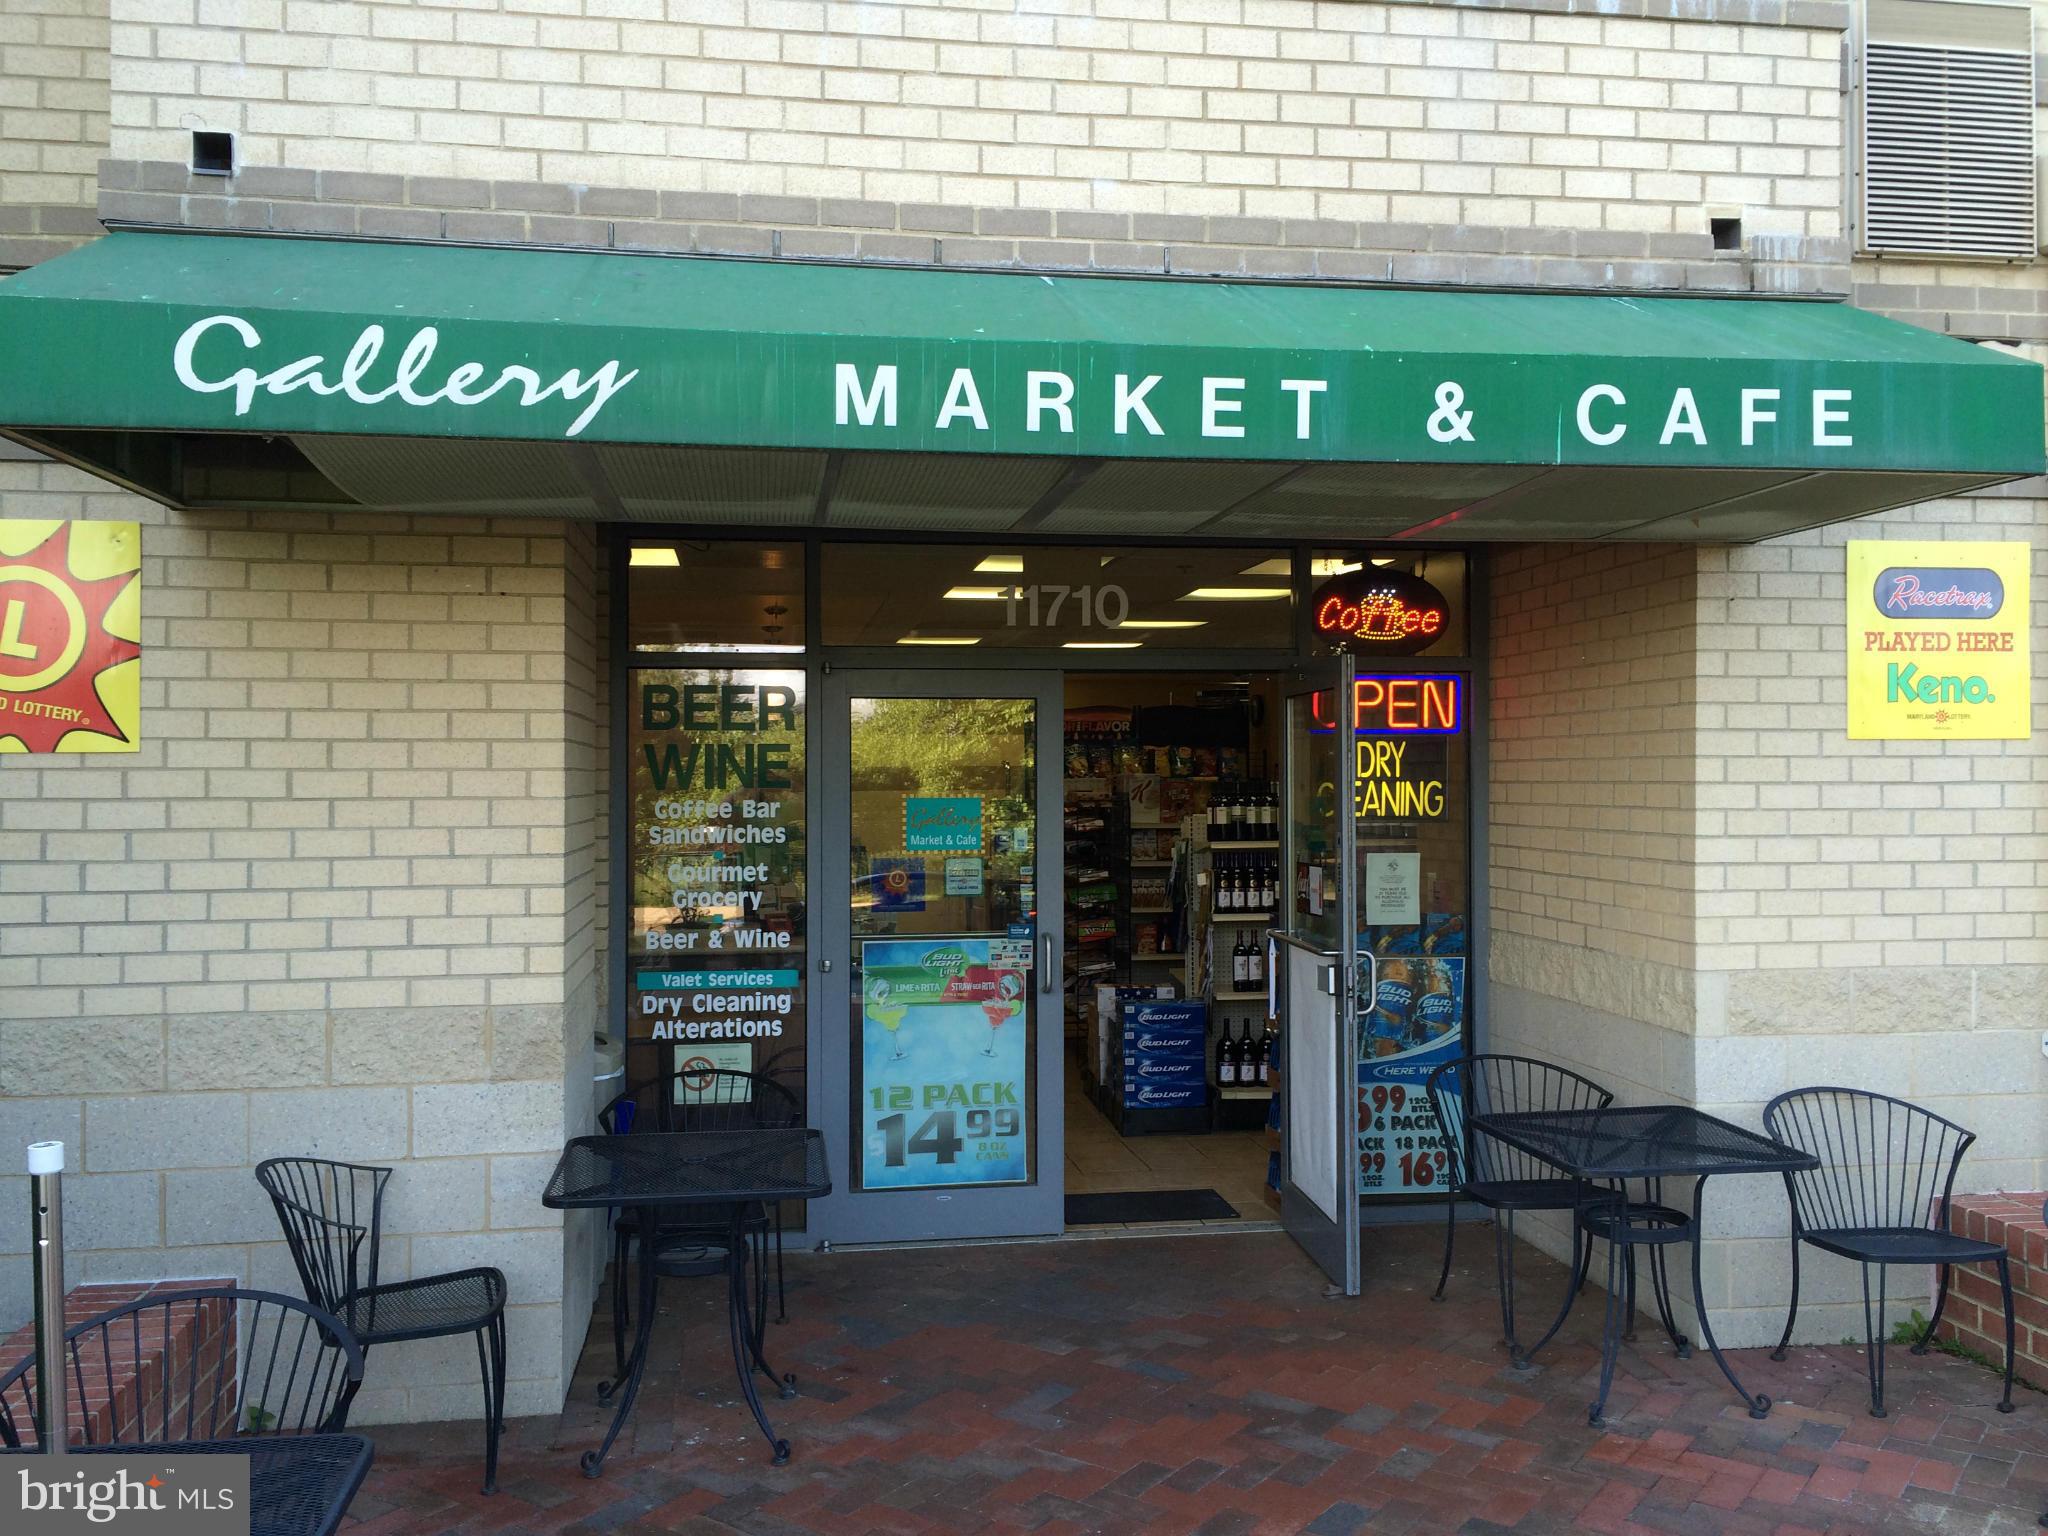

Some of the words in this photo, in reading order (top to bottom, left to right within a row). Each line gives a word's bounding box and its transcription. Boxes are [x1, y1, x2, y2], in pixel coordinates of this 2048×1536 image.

[174, 315, 639, 437] Gallery
[835, 363, 1328, 440] MARKET
[1426, 381, 1475, 443] &
[1576, 384, 1853, 446] CAFE
[996, 584, 1129, 628] 11710
[1864, 631, 1951, 652] PLAYED
[1956, 632, 2014, 652] HERE
[643, 684, 797, 731] BEER
[643, 743, 792, 791] WINE
[1356, 740, 1407, 778] DRY
[654, 800, 733, 820] Coffee
[742, 800, 781, 818] Bar
[649, 824, 786, 845] Sandwiches
[910, 835, 943, 845] Market
[945, 836, 953, 845] &
[956, 835, 977, 845] Cafe
[667, 862, 768, 883] Gourmet
[672, 889, 763, 910] Grocery
[645, 931, 699, 950] Beer
[708, 930, 723, 949] &
[733, 928, 791, 949] Wine
[661, 973, 703, 987] Valet
[708, 972, 773, 986] Services
[1376, 993, 1413, 1006] IGHT
[1377, 984, 1412, 998] BUD
[642, 995, 683, 1017] Dry
[692, 992, 791, 1014] Cleaning
[1422, 998, 1452, 1007] BUD
[1141, 1013, 1163, 1021] BUD
[651, 1018, 783, 1040] Alterations
[1141, 1039, 1163, 1047] BUD
[1141, 1065, 1163, 1073] BUD
[1384, 1066, 1416, 1075] HERE
[1418, 1066, 1437, 1075] WE
[870, 1086, 913, 1111] 12
[922, 1081, 1017, 1109] PACK
[1141, 1091, 1163, 1099] BUD
[1374, 1115, 1386, 1131] 6
[1390, 1115, 1438, 1131] PACK
[1394, 1136, 1414, 1150] 18
